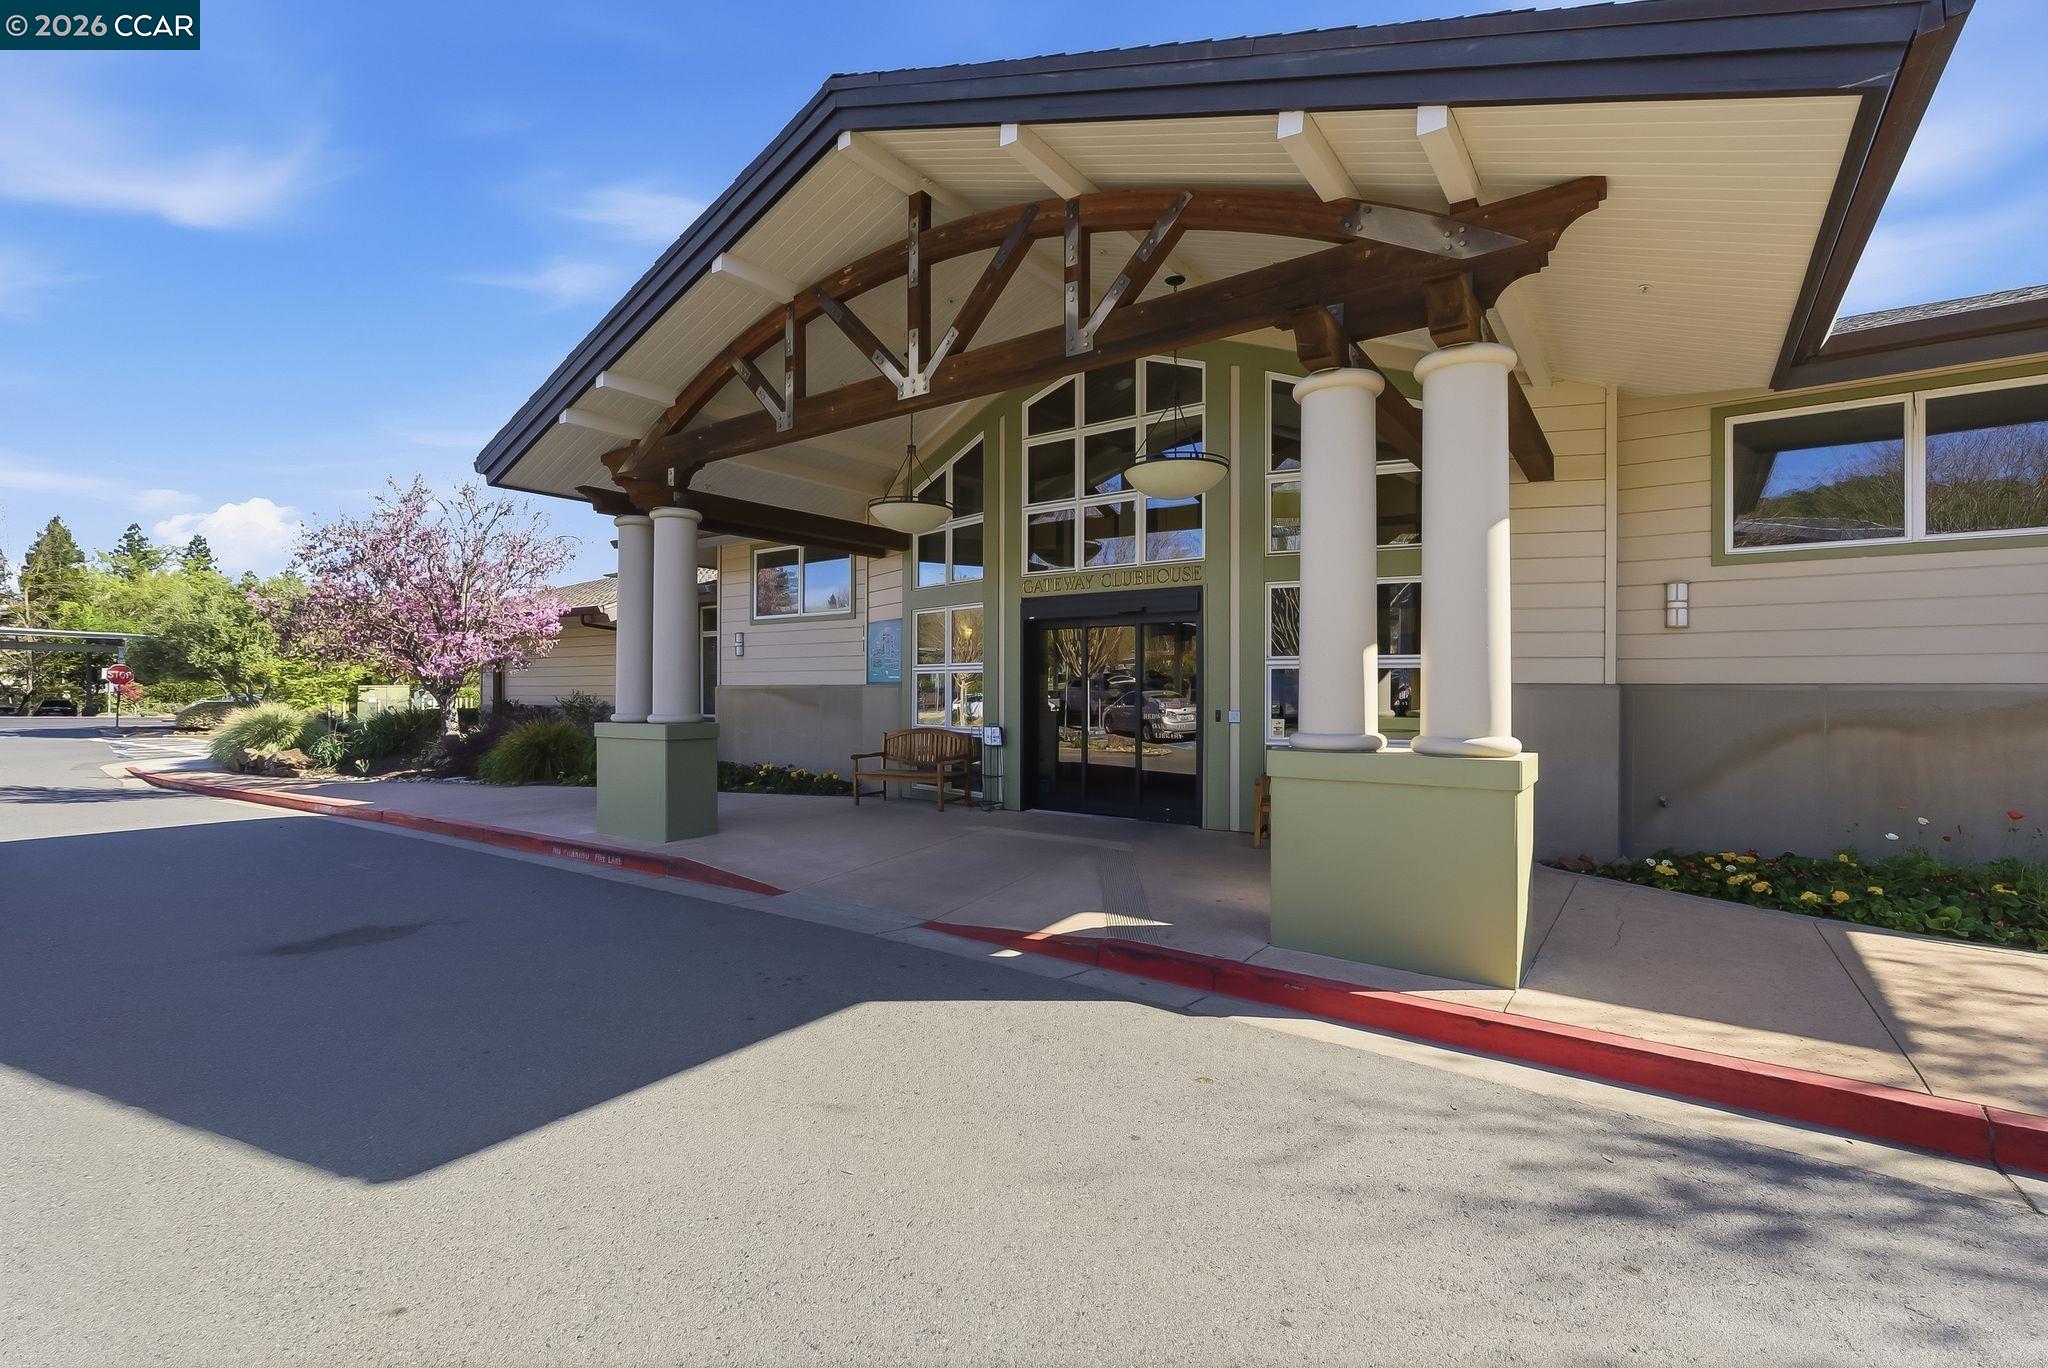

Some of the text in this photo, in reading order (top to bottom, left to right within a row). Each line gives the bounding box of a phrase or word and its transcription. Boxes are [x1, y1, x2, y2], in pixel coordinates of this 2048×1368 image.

[1022, 566, 1202, 594] GATEWAY CLUBHOUSE
[107, 670, 131, 679] STOP
